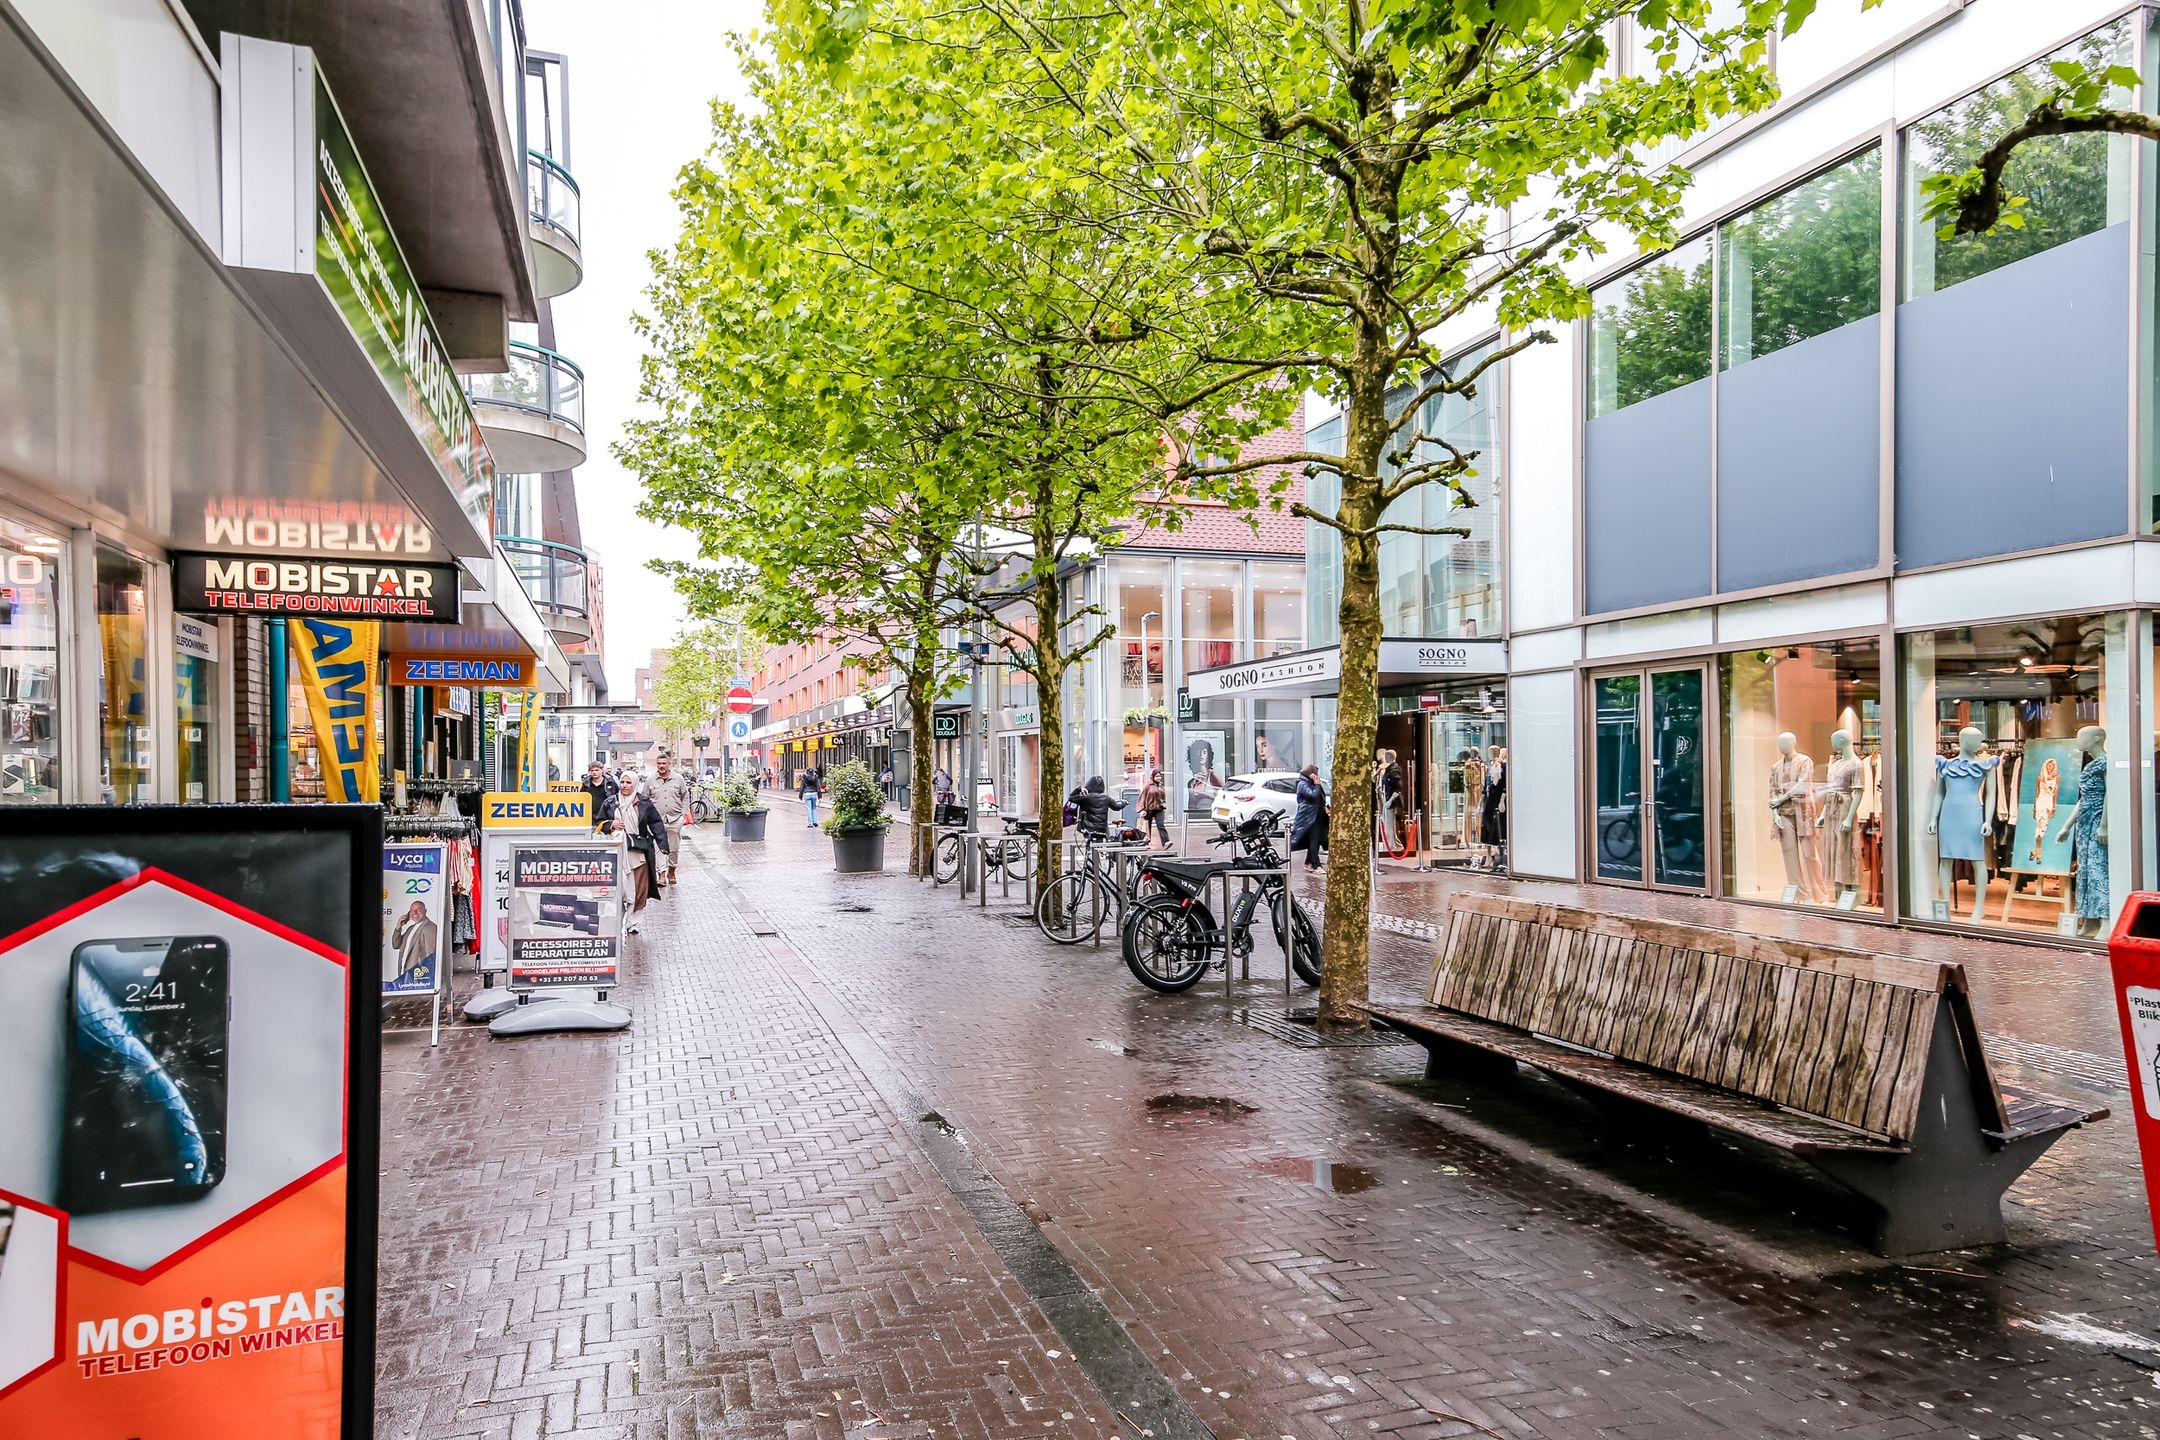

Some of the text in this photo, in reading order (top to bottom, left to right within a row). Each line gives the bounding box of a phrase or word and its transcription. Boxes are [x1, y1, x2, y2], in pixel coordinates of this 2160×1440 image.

[404, 288, 470, 476] MOBISTAR
[204, 559, 433, 598] MOBISTAR
[204, 590, 434, 616] TELEFOONWINKEL
[182, 622, 202, 637] MOBISTAR
[176, 634, 210, 654] ELEFOONWINKEL
[1418, 648, 1466, 659] SOGNO
[406, 660, 520, 680] ZEEMAN
[1220, 662, 1325, 690] SOGNO FASHION
[491, 803, 584, 818] ZEEMAN
[390, 853, 424, 866] Lyca
[521, 861, 612, 875] MOBISTAR
[520, 874, 613, 883] TELEFOONWINKEL
[521, 939, 608, 950] ACCESSOIRES EN
[521, 948, 608, 959] REPARATIES VAN
[125, 981, 177, 1002] 2:41
[78, 1320, 344, 1379] TELEFOON WINKEL
